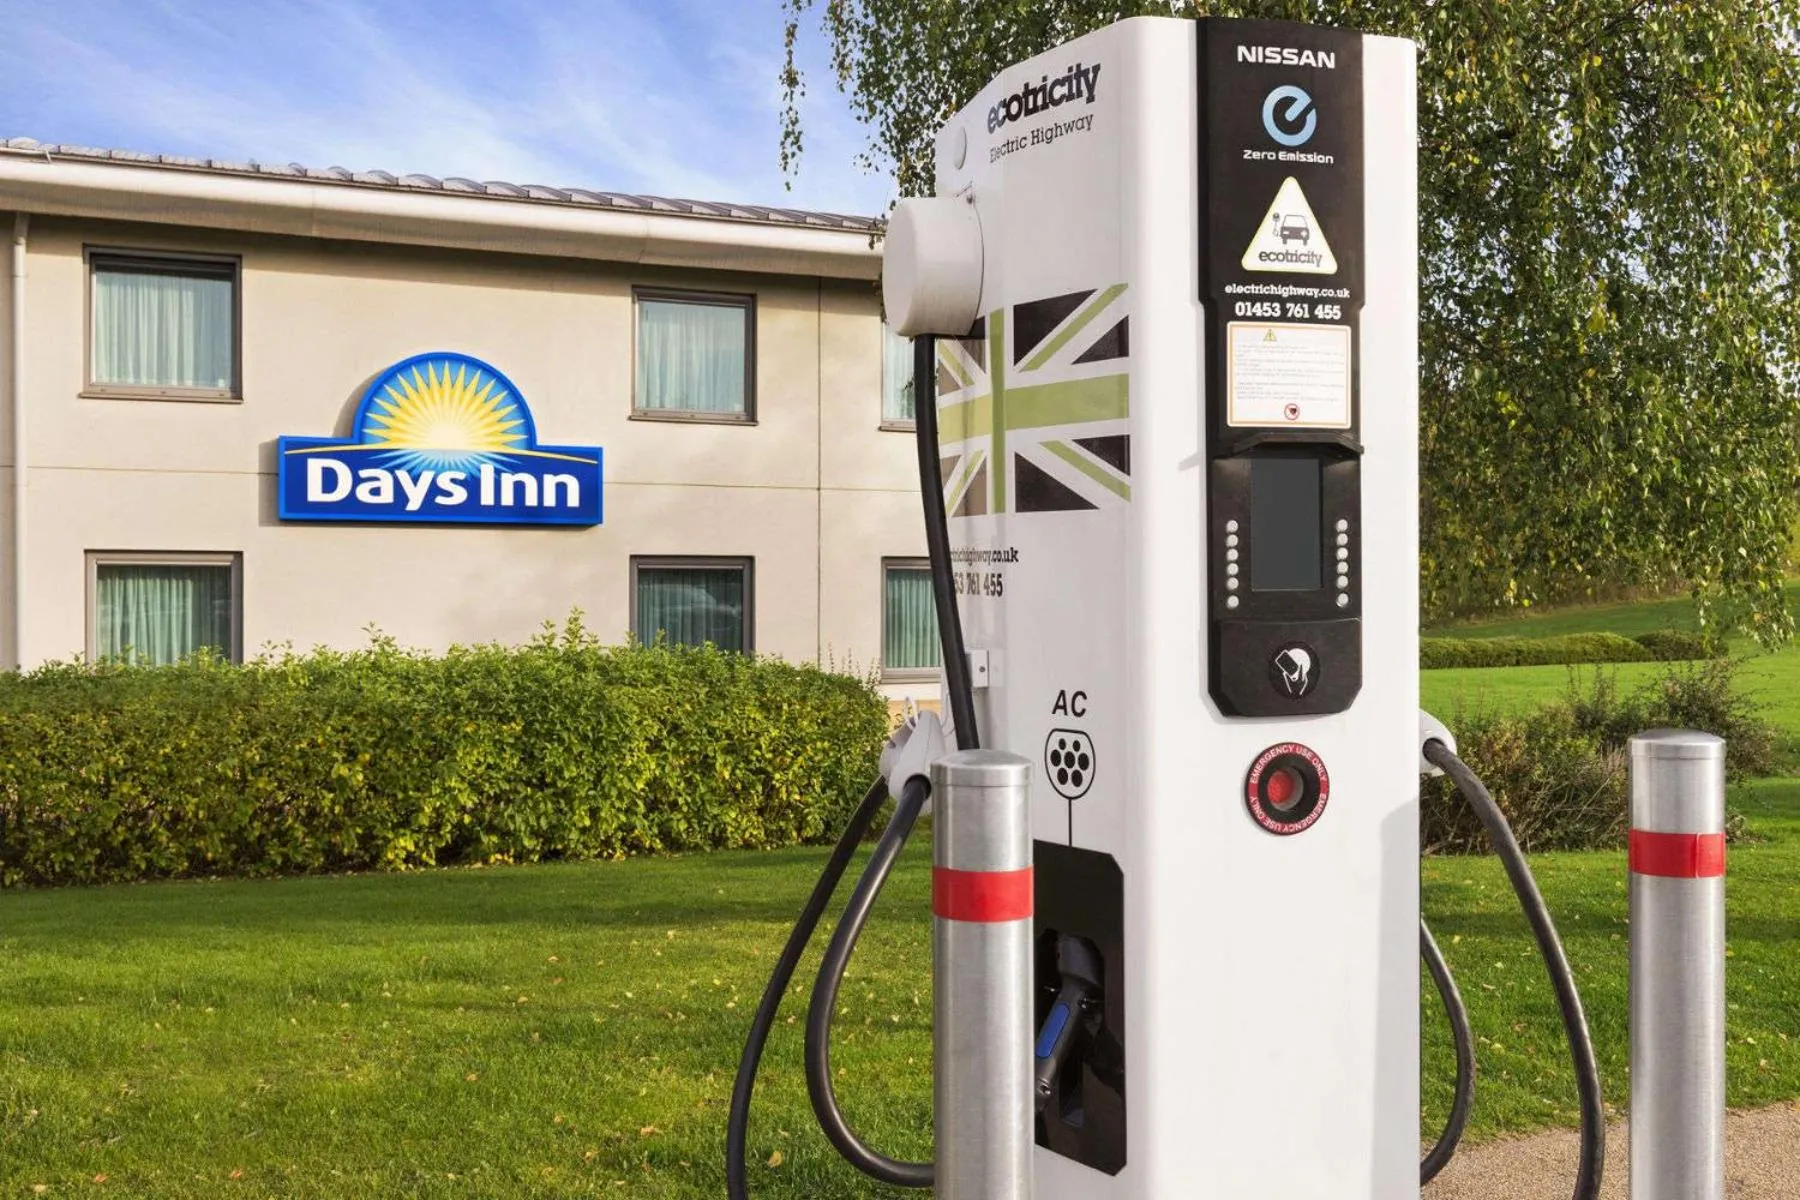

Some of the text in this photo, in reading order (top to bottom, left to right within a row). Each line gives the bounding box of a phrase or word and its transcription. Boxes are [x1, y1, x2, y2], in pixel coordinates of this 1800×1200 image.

[1237, 45, 1336, 69] NISSAN
[987, 63, 1101, 134] ecotricity
[1030, 114, 1094, 146] Highway
[1242, 149, 1335, 165] Zero Emission
[1258, 249, 1323, 268] ecotricity
[1224, 283, 1351, 299] electrichighway.co.uk
[1234, 301, 1343, 321] 01453 761 455
[306, 457, 581, 512] Days Inn
[966, 572, 980, 595] 761
[983, 573, 1003, 597] 455
[1051, 689, 1088, 718] AC
[1250, 745, 1327, 784] EMERGENCY USE ONLY
[1249, 793, 1328, 832] EMERGENCY USE ONLY
